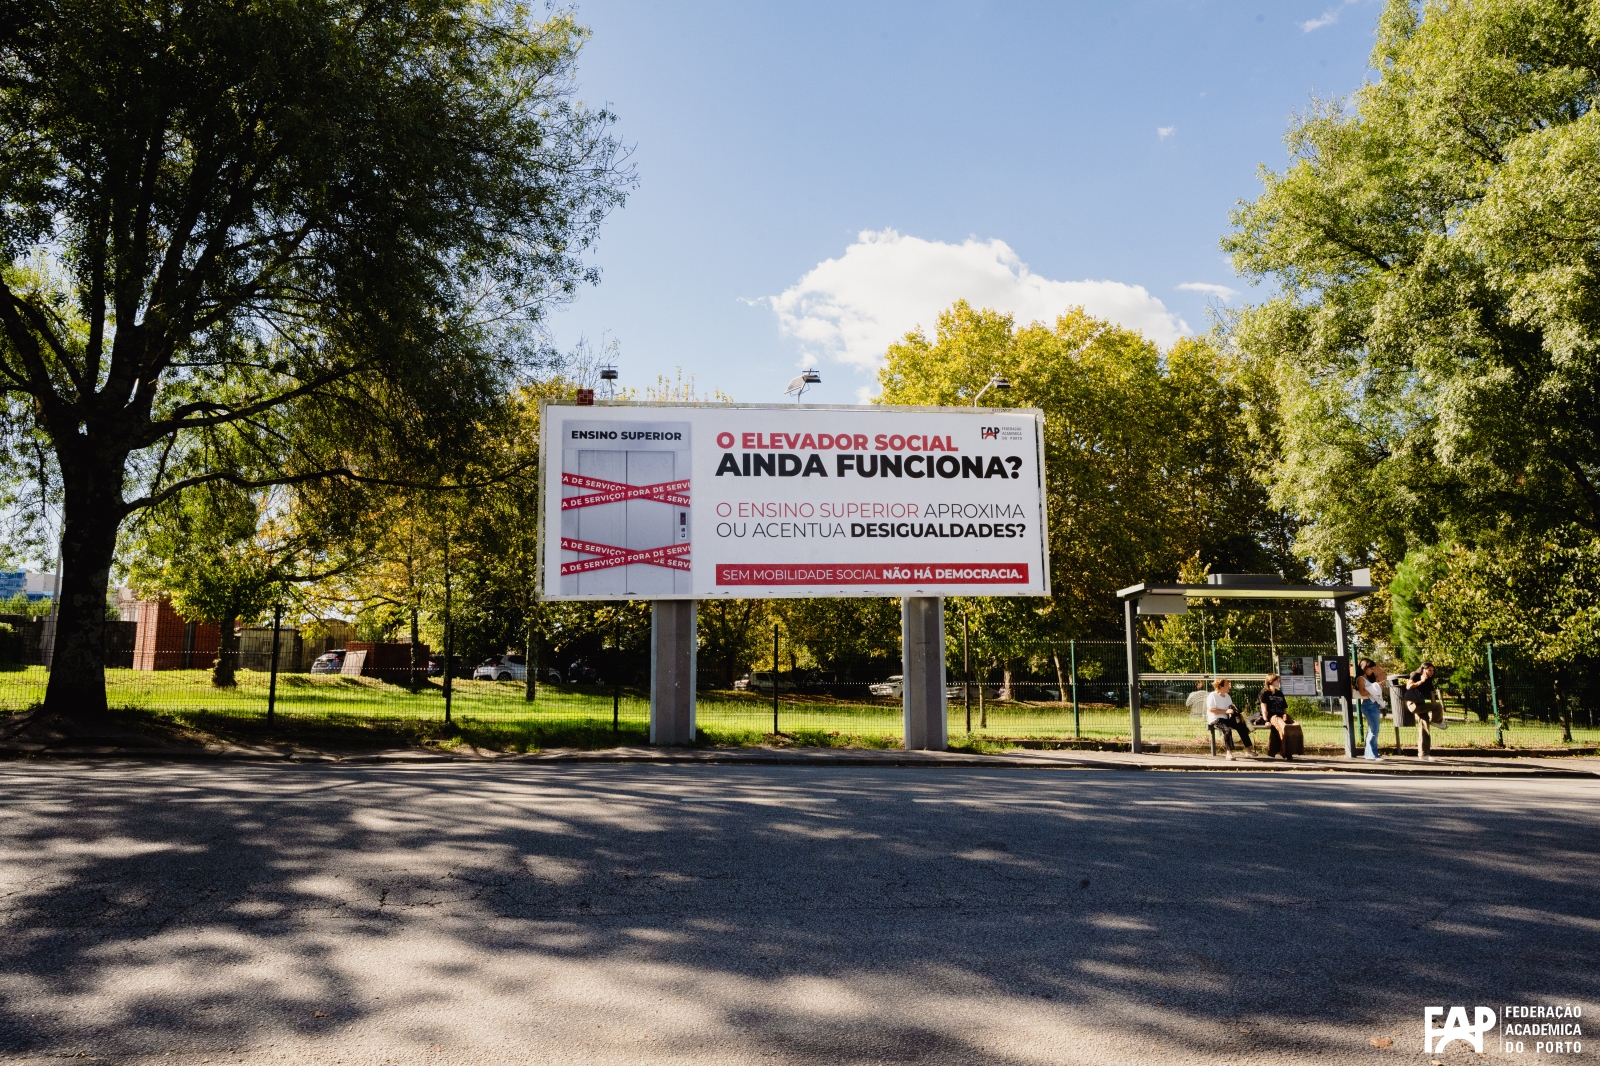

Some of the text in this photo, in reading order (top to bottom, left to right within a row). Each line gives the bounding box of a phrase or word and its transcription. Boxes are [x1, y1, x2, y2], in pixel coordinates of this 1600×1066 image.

[572, 430, 681, 441] ENSINO SUPERIOR
[716, 432, 958, 452] O ELEVADOR SOCIAL
[981, 427, 1000, 440] FAP
[715, 453, 1022, 479] AINDA FUNCIONA?
[570, 499, 582, 507] DE
[584, 492, 624, 504] SERVIÇO?
[628, 489, 650, 498] FORA
[716, 502, 1025, 519] O ENSINO SUPERIOR APROXIMA
[716, 522, 1026, 538] OU ACENTUA DESIGUALDADES?
[570, 564, 582, 572] DE
[584, 557, 624, 569] SERVIÇO?
[628, 553, 650, 562] FORA
[723, 566, 1022, 581] SEM MOBILIDADE SOCIAL NÃO HÁ DEMOCRACIA.
